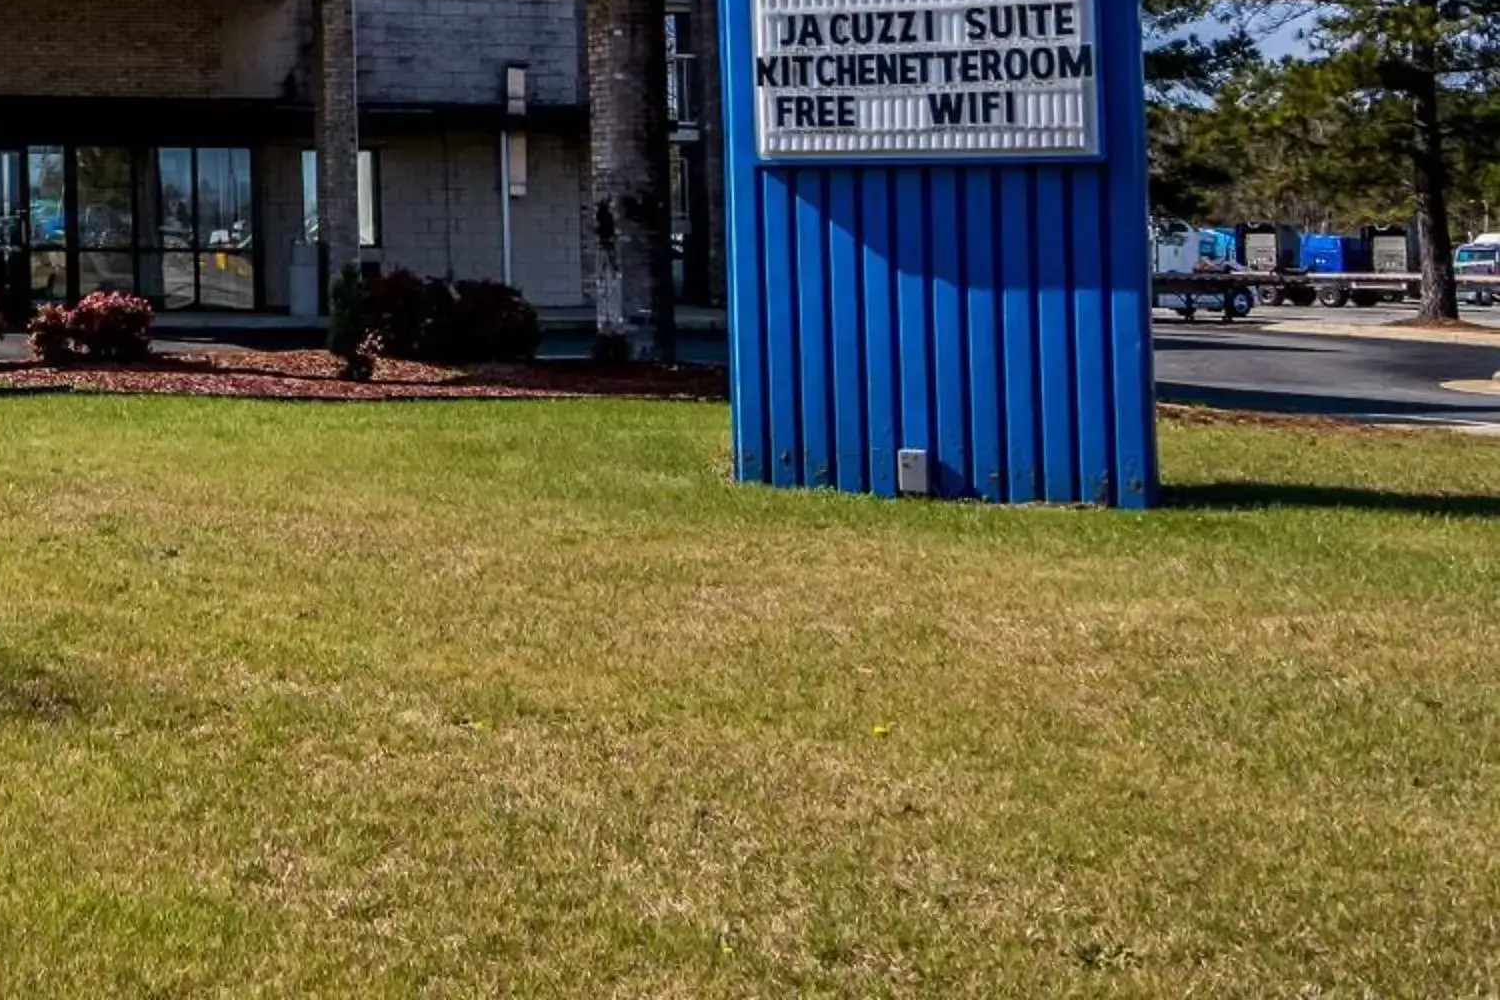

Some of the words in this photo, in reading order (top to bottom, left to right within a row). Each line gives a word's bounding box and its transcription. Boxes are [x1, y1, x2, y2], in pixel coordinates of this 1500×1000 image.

[779, 9, 934, 46] JACUZZI
[964, 2, 1076, 41] SUITE
[776, 95, 856, 128] FREE
[928, 91, 1015, 126] WIFI
